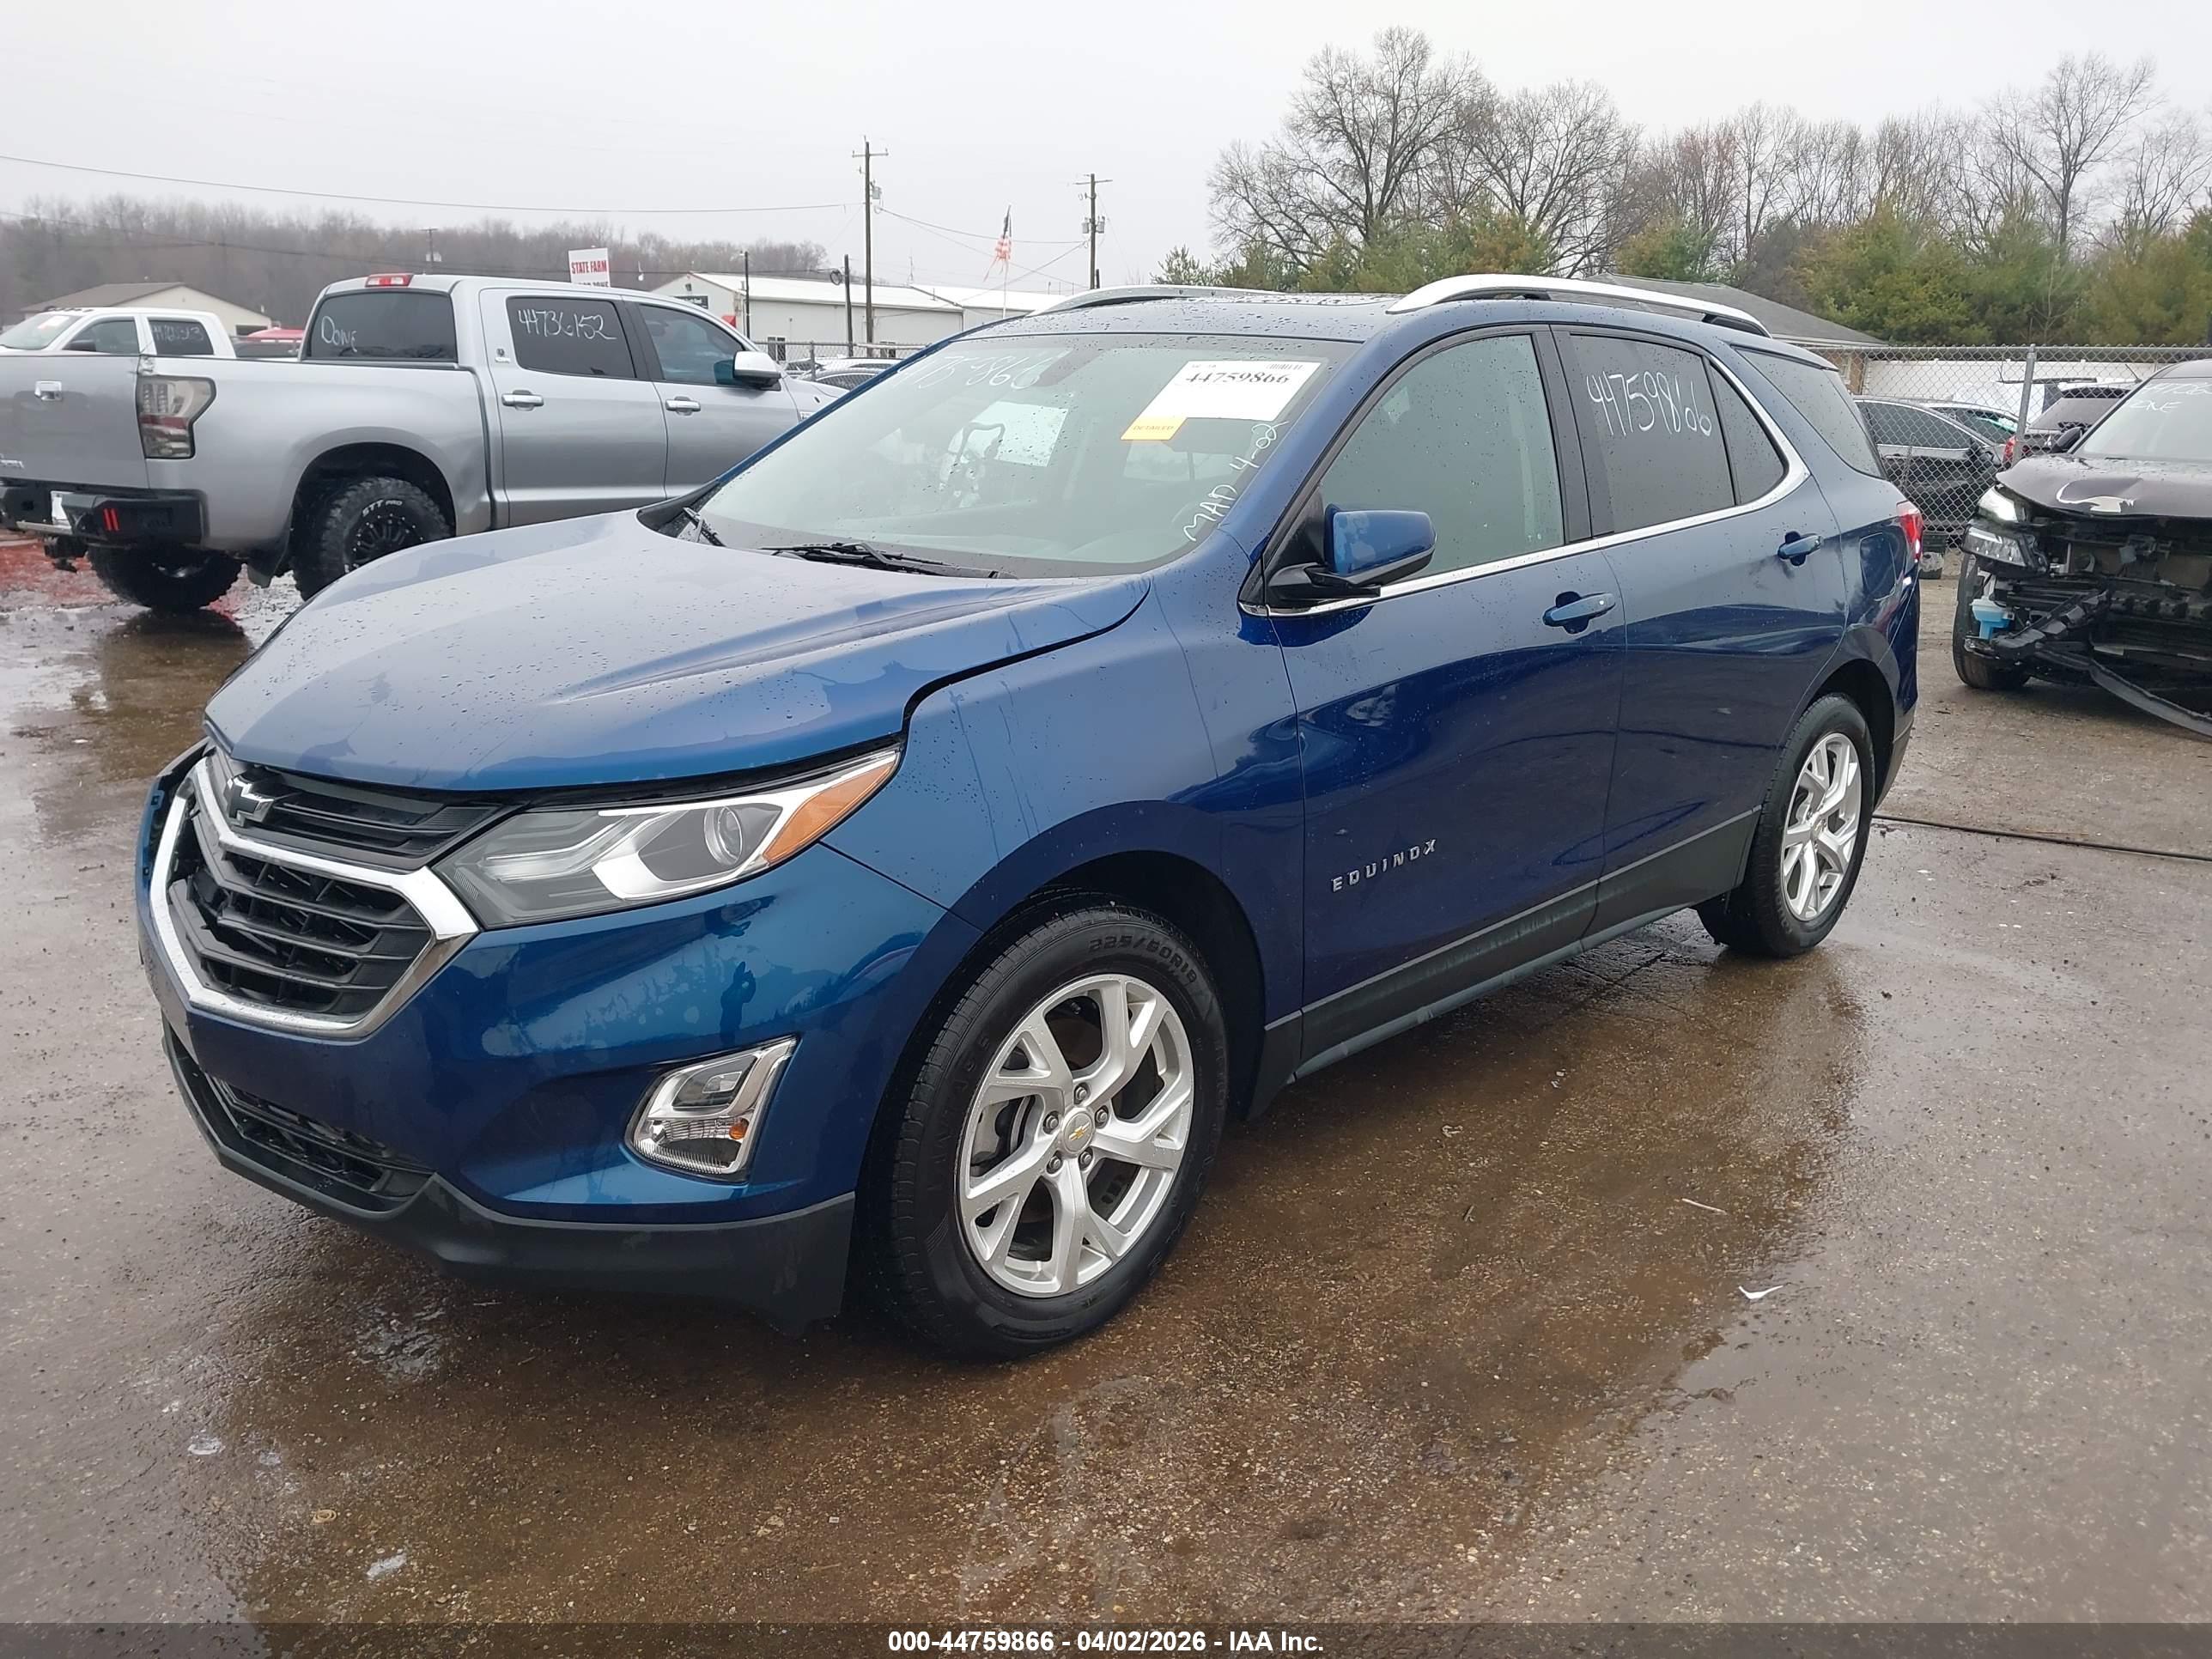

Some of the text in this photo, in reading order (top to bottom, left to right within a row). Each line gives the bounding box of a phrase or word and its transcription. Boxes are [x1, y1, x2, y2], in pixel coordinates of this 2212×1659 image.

[571, 260, 607, 274] STATE FARM
[518, 308, 617, 339] 44736152
[1186, 371, 1291, 383] 44759866
[1586, 371, 1712, 436] 44759866
[362, 500, 384, 517] STT
[1183, 484, 1237, 541] MAD
[1331, 839, 1437, 893] EQUINOX
